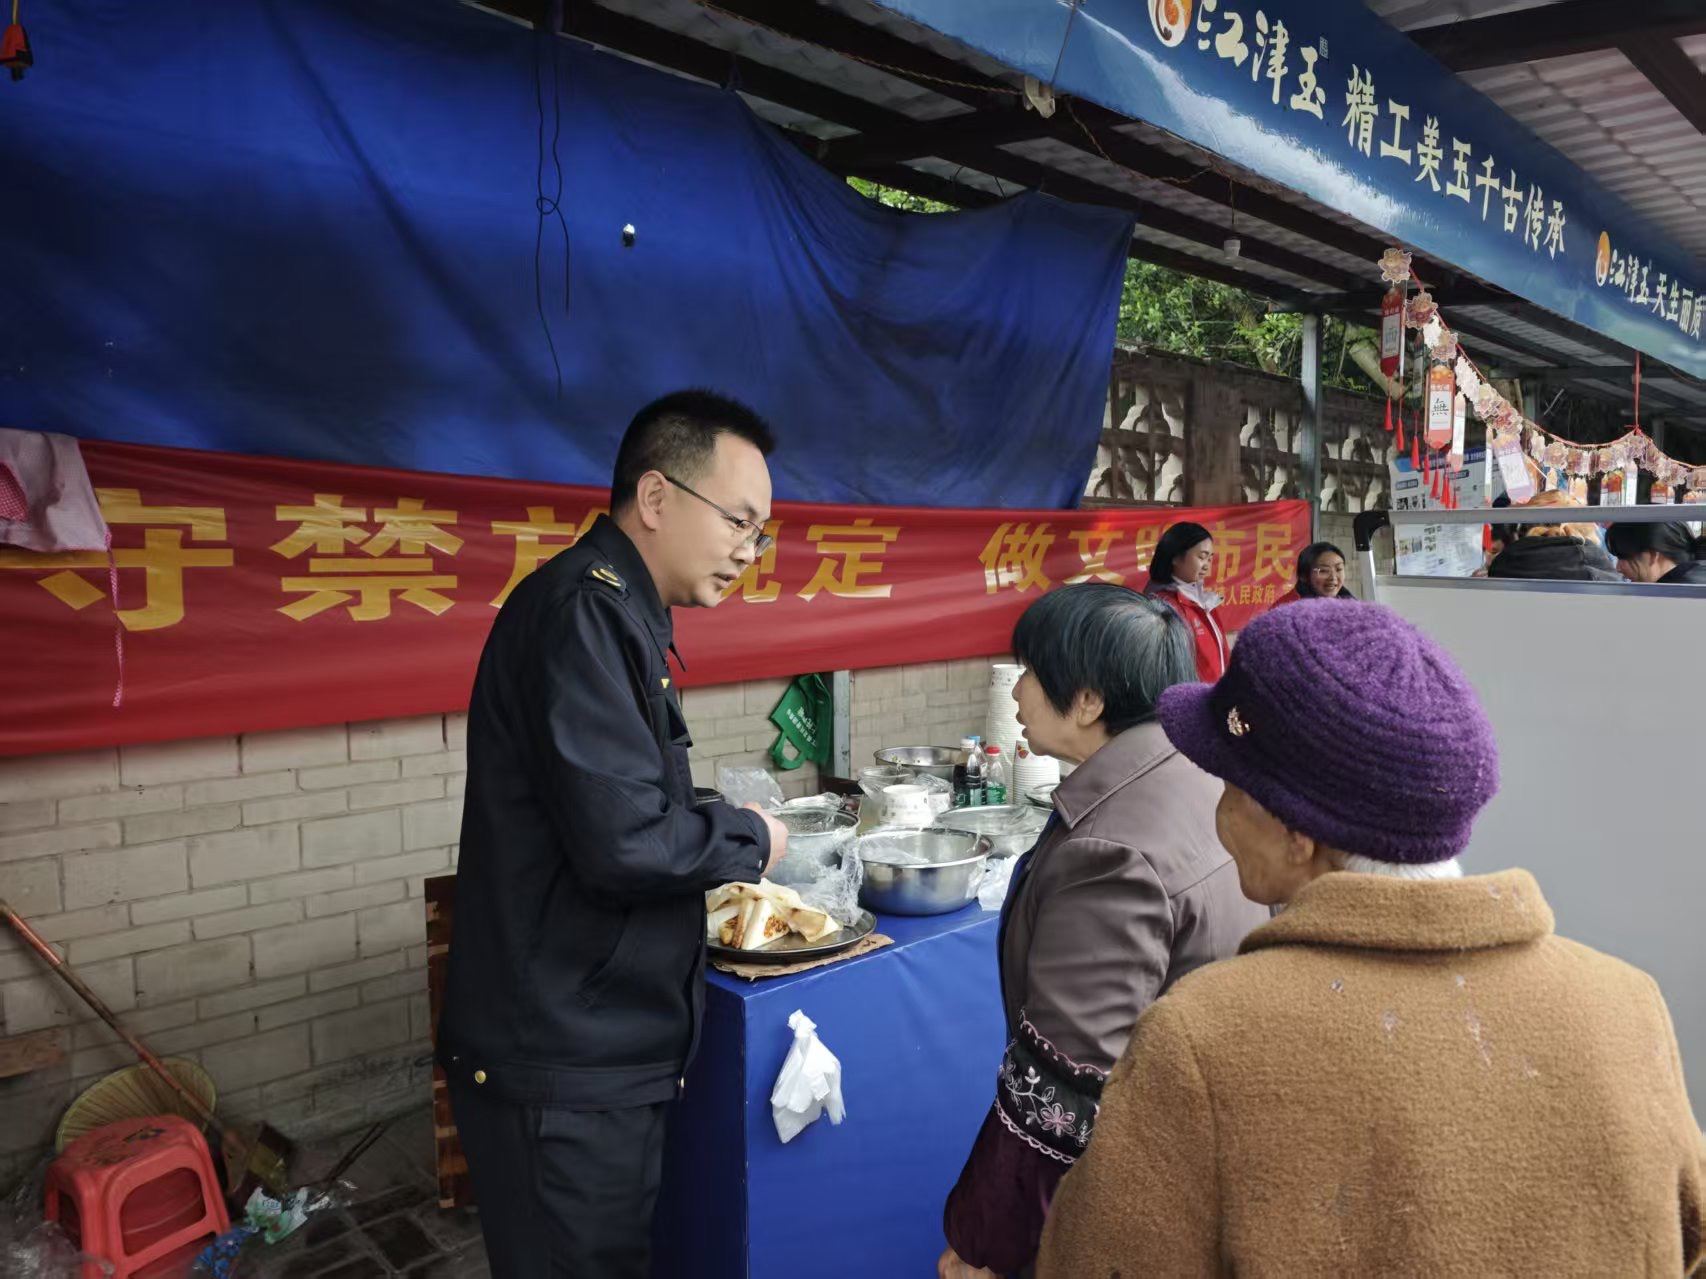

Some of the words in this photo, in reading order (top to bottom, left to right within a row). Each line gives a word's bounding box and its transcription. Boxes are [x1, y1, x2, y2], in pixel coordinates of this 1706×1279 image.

[1197, 0, 1326, 120] 江津玉
[1341, 63, 1567, 261] 精工美玉千古传承
[1609, 248, 1650, 306] 江津玉
